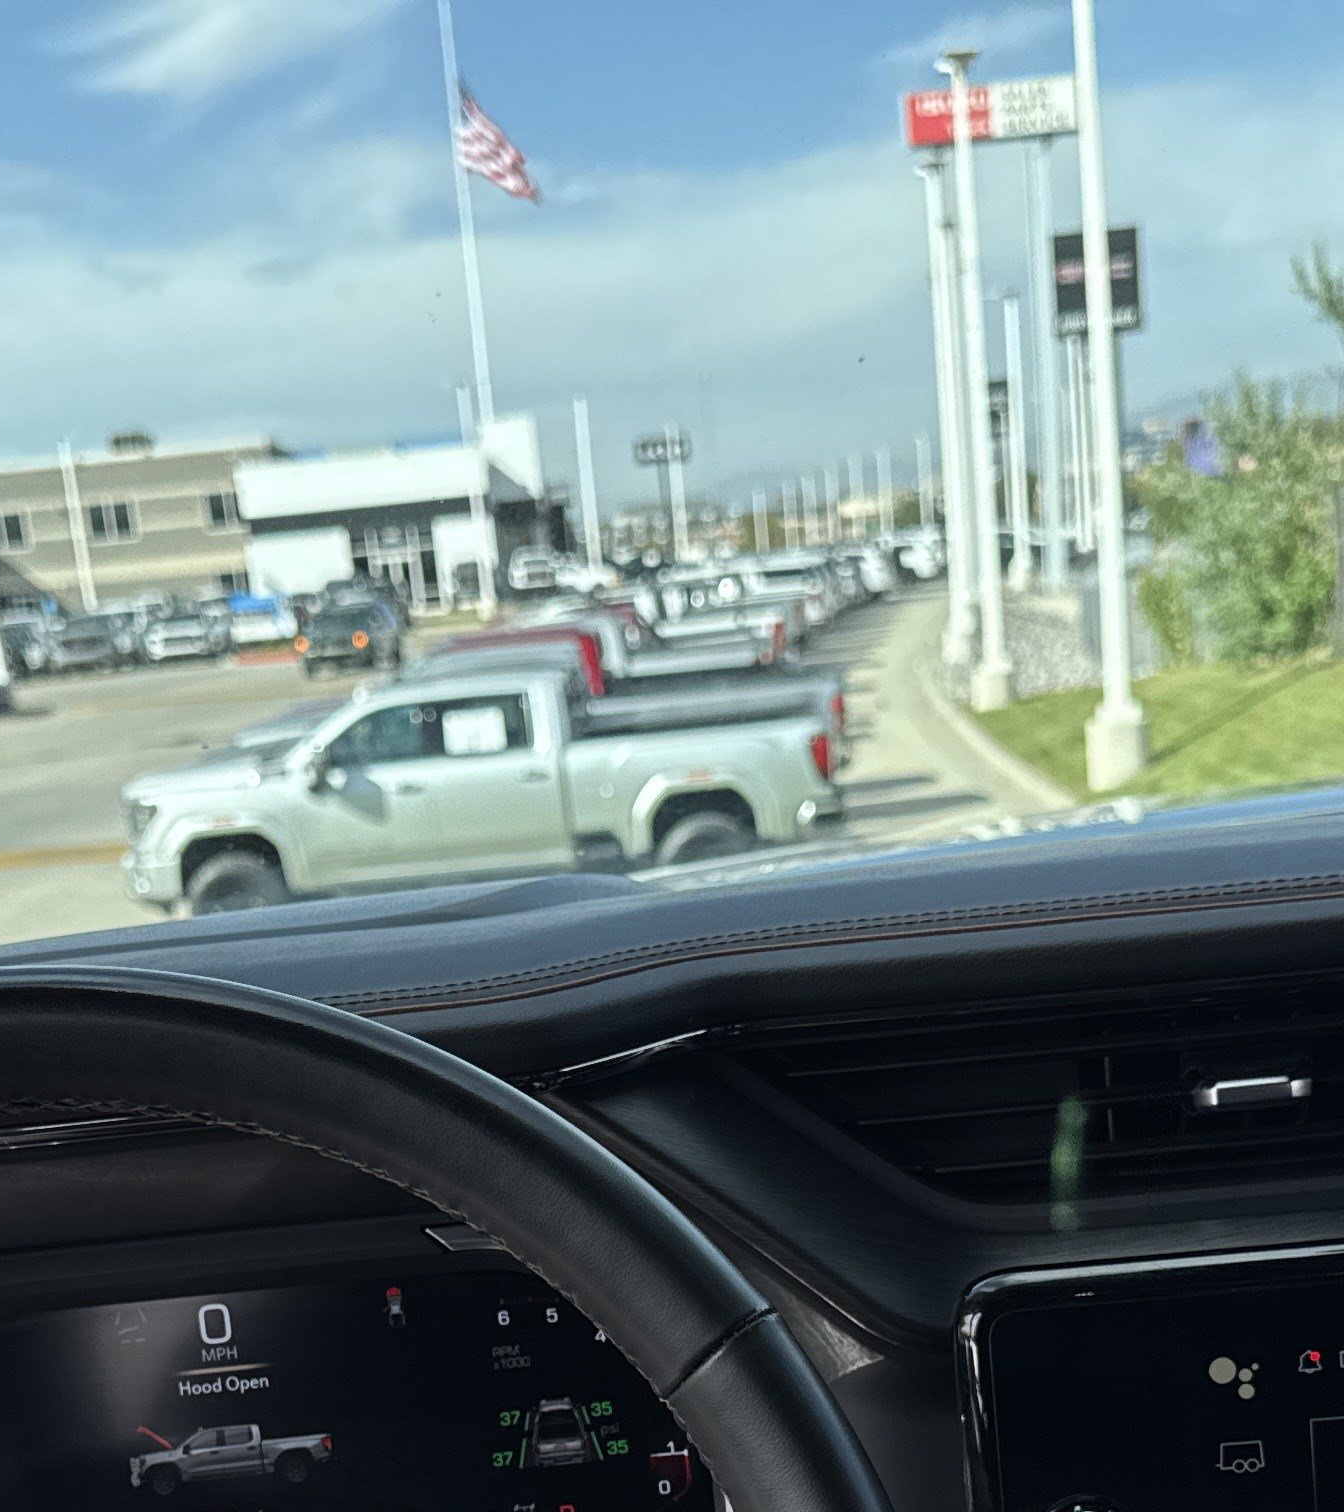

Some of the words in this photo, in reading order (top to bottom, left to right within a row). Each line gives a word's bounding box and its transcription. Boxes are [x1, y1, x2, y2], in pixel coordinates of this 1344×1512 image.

[498, 1309, 510, 1326] 6
[545, 1307, 558, 1323] 5
[198, 1303, 232, 1345] 0
[201, 1345, 239, 1363] MPH
[178, 1379, 222, 1397] Hood
[225, 1375, 269, 1394] Open
[590, 1401, 613, 1417] 35
[499, 1410, 521, 1427] 37
[606, 1439, 629, 1456] 35
[492, 1451, 513, 1468] 37
[658, 1479, 671, 1495] 0
